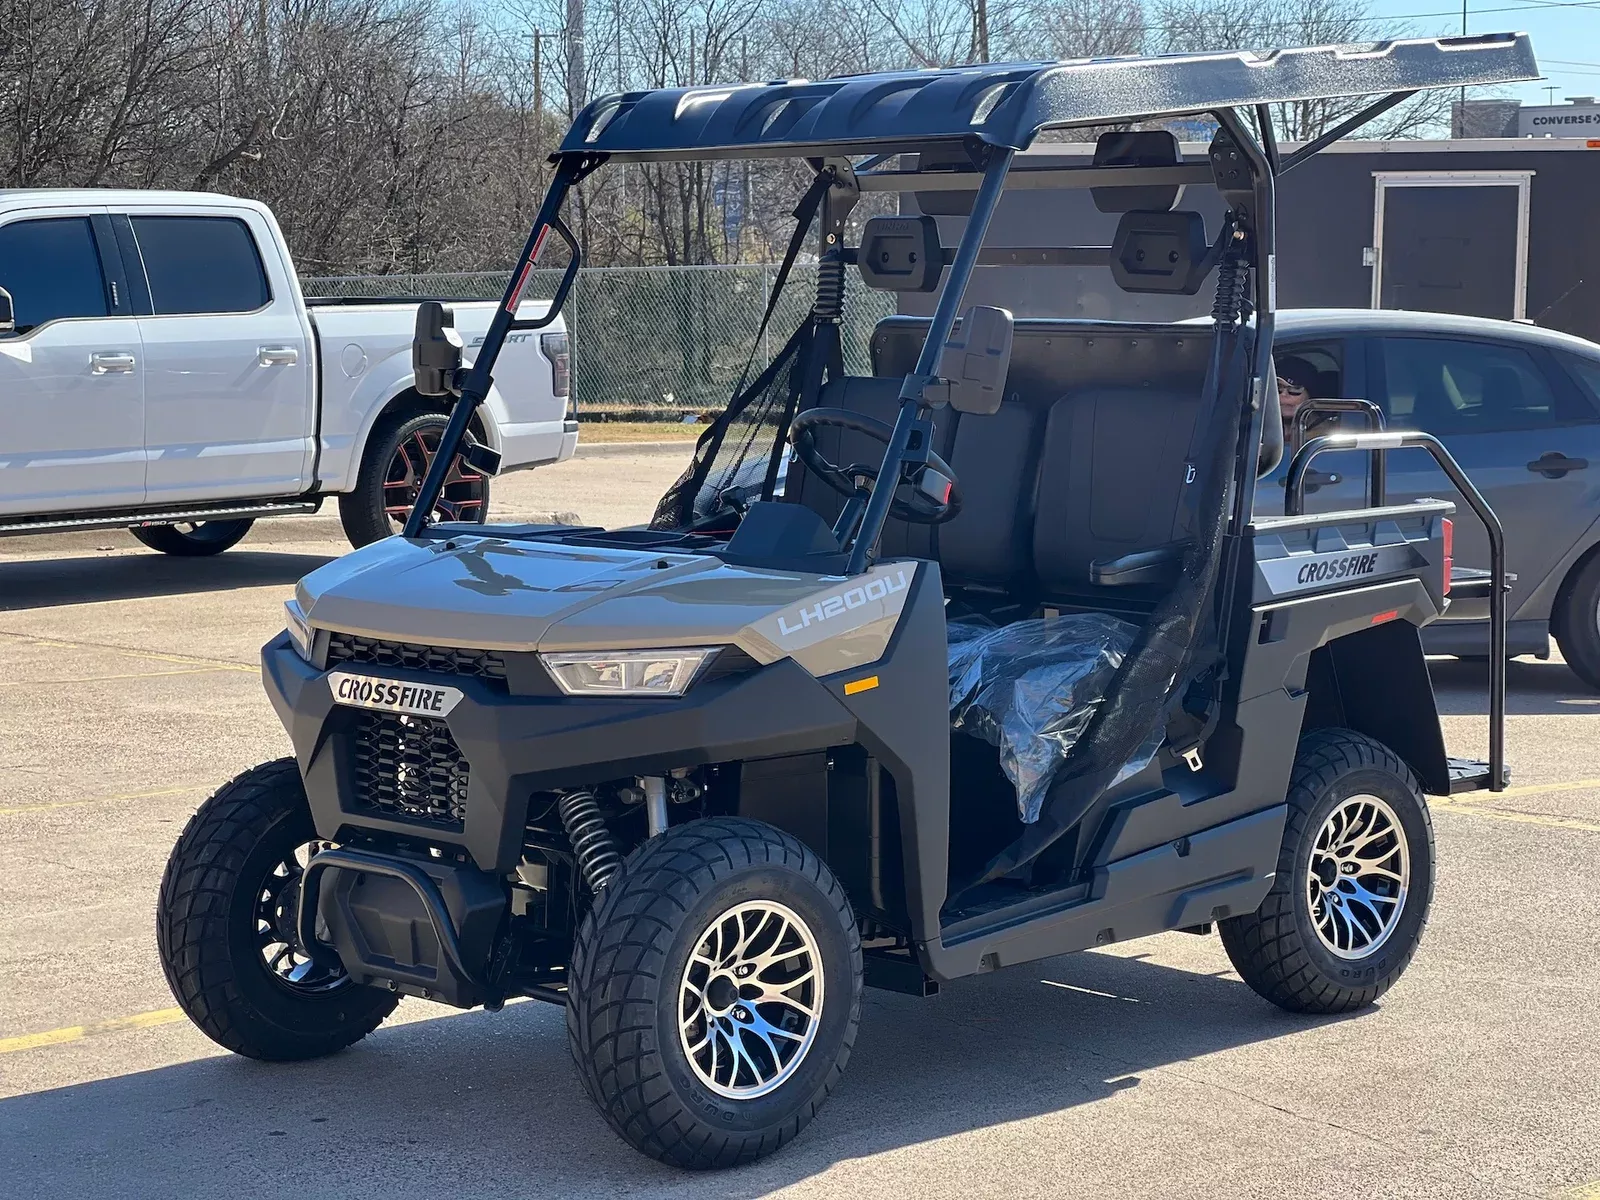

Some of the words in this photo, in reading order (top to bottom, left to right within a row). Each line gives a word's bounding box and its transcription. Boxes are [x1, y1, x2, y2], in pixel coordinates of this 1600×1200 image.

[1533, 115, 1591, 125] CONVERSE
[1298, 553, 1378, 584] CROSSFIRE
[777, 571, 907, 636] LH200U
[338, 678, 446, 711] CROSSFIRE
